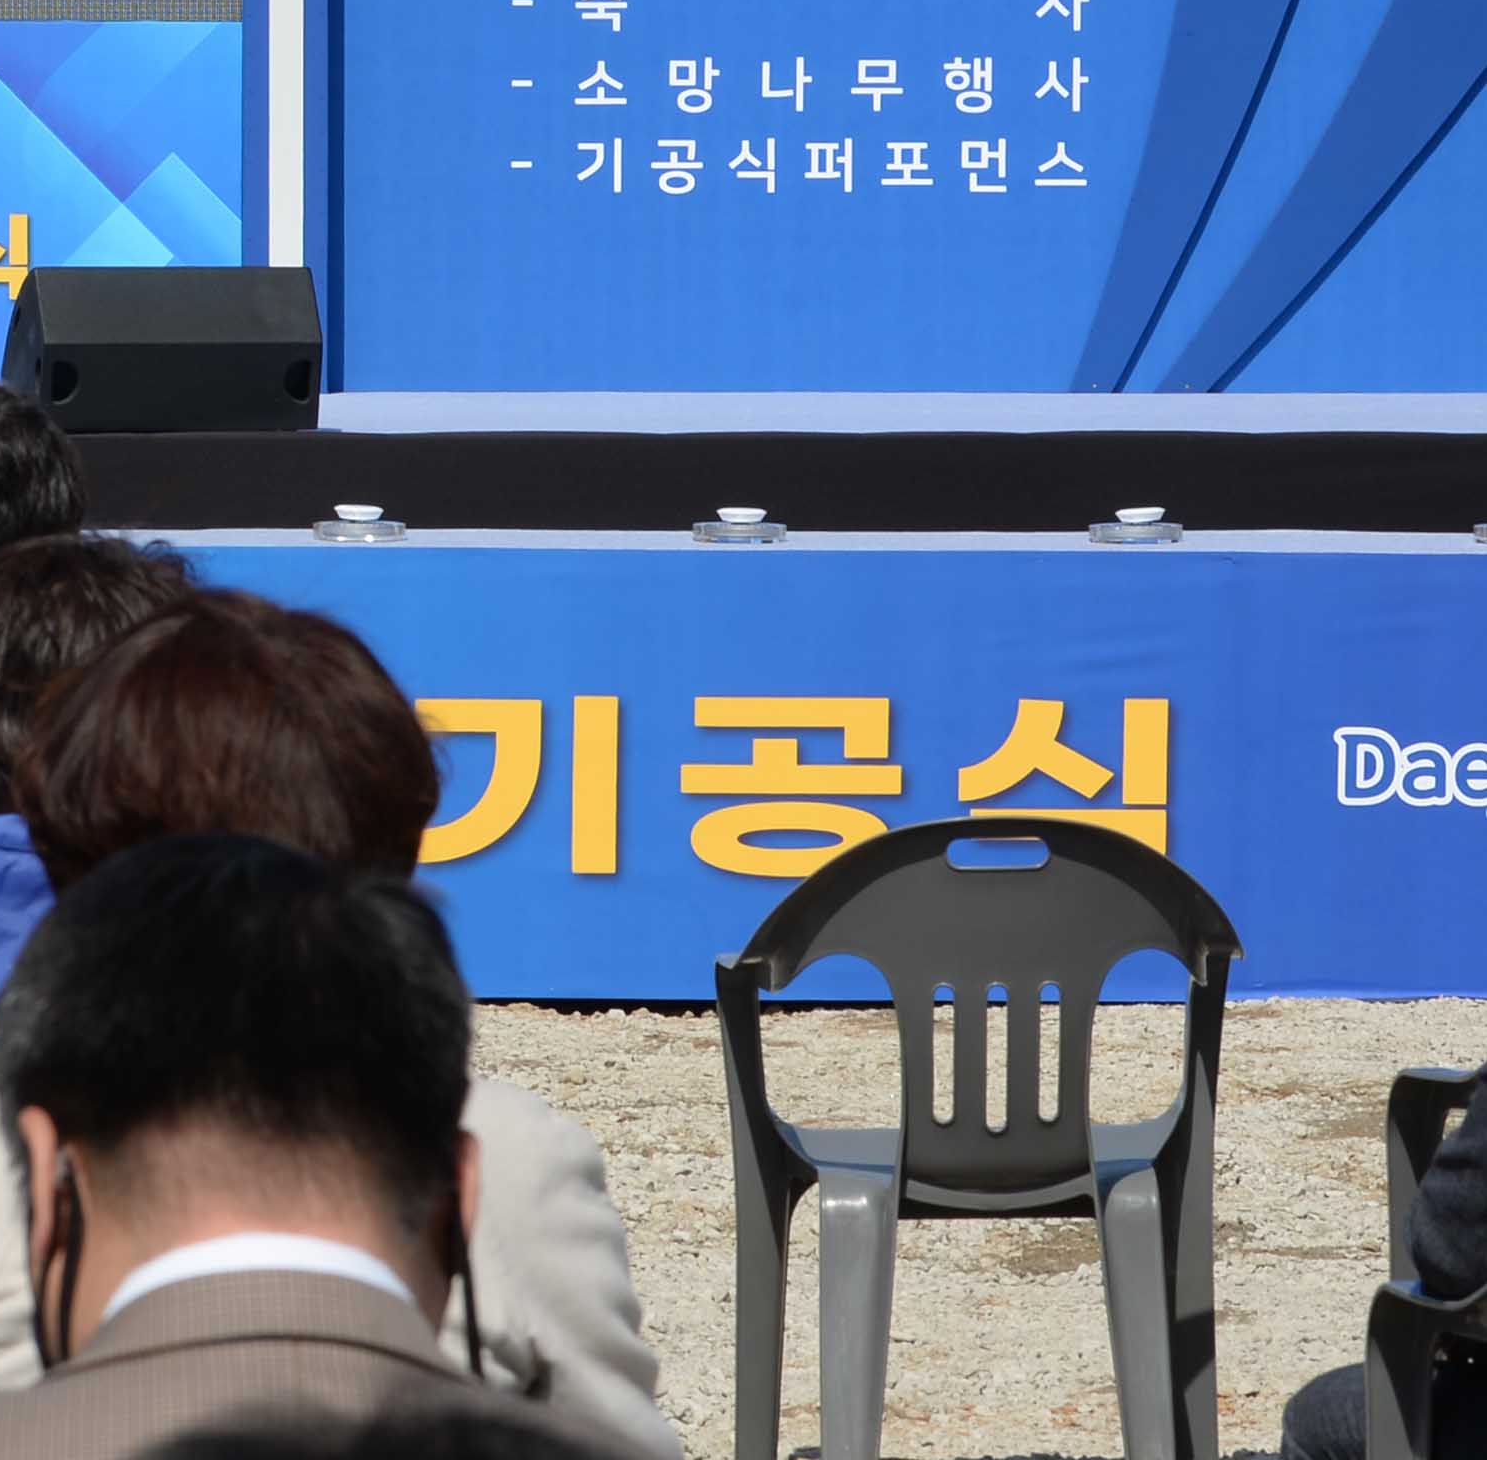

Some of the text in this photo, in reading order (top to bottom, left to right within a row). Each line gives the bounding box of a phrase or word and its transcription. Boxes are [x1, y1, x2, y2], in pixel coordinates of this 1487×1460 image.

[574, 55, 1090, 114] 소망나무행사
[575, 137, 1089, 195] 기공식퍼포먼스
[413, 694, 1170, 879] 기공식
[1333, 726, 1487, 807] Dae
